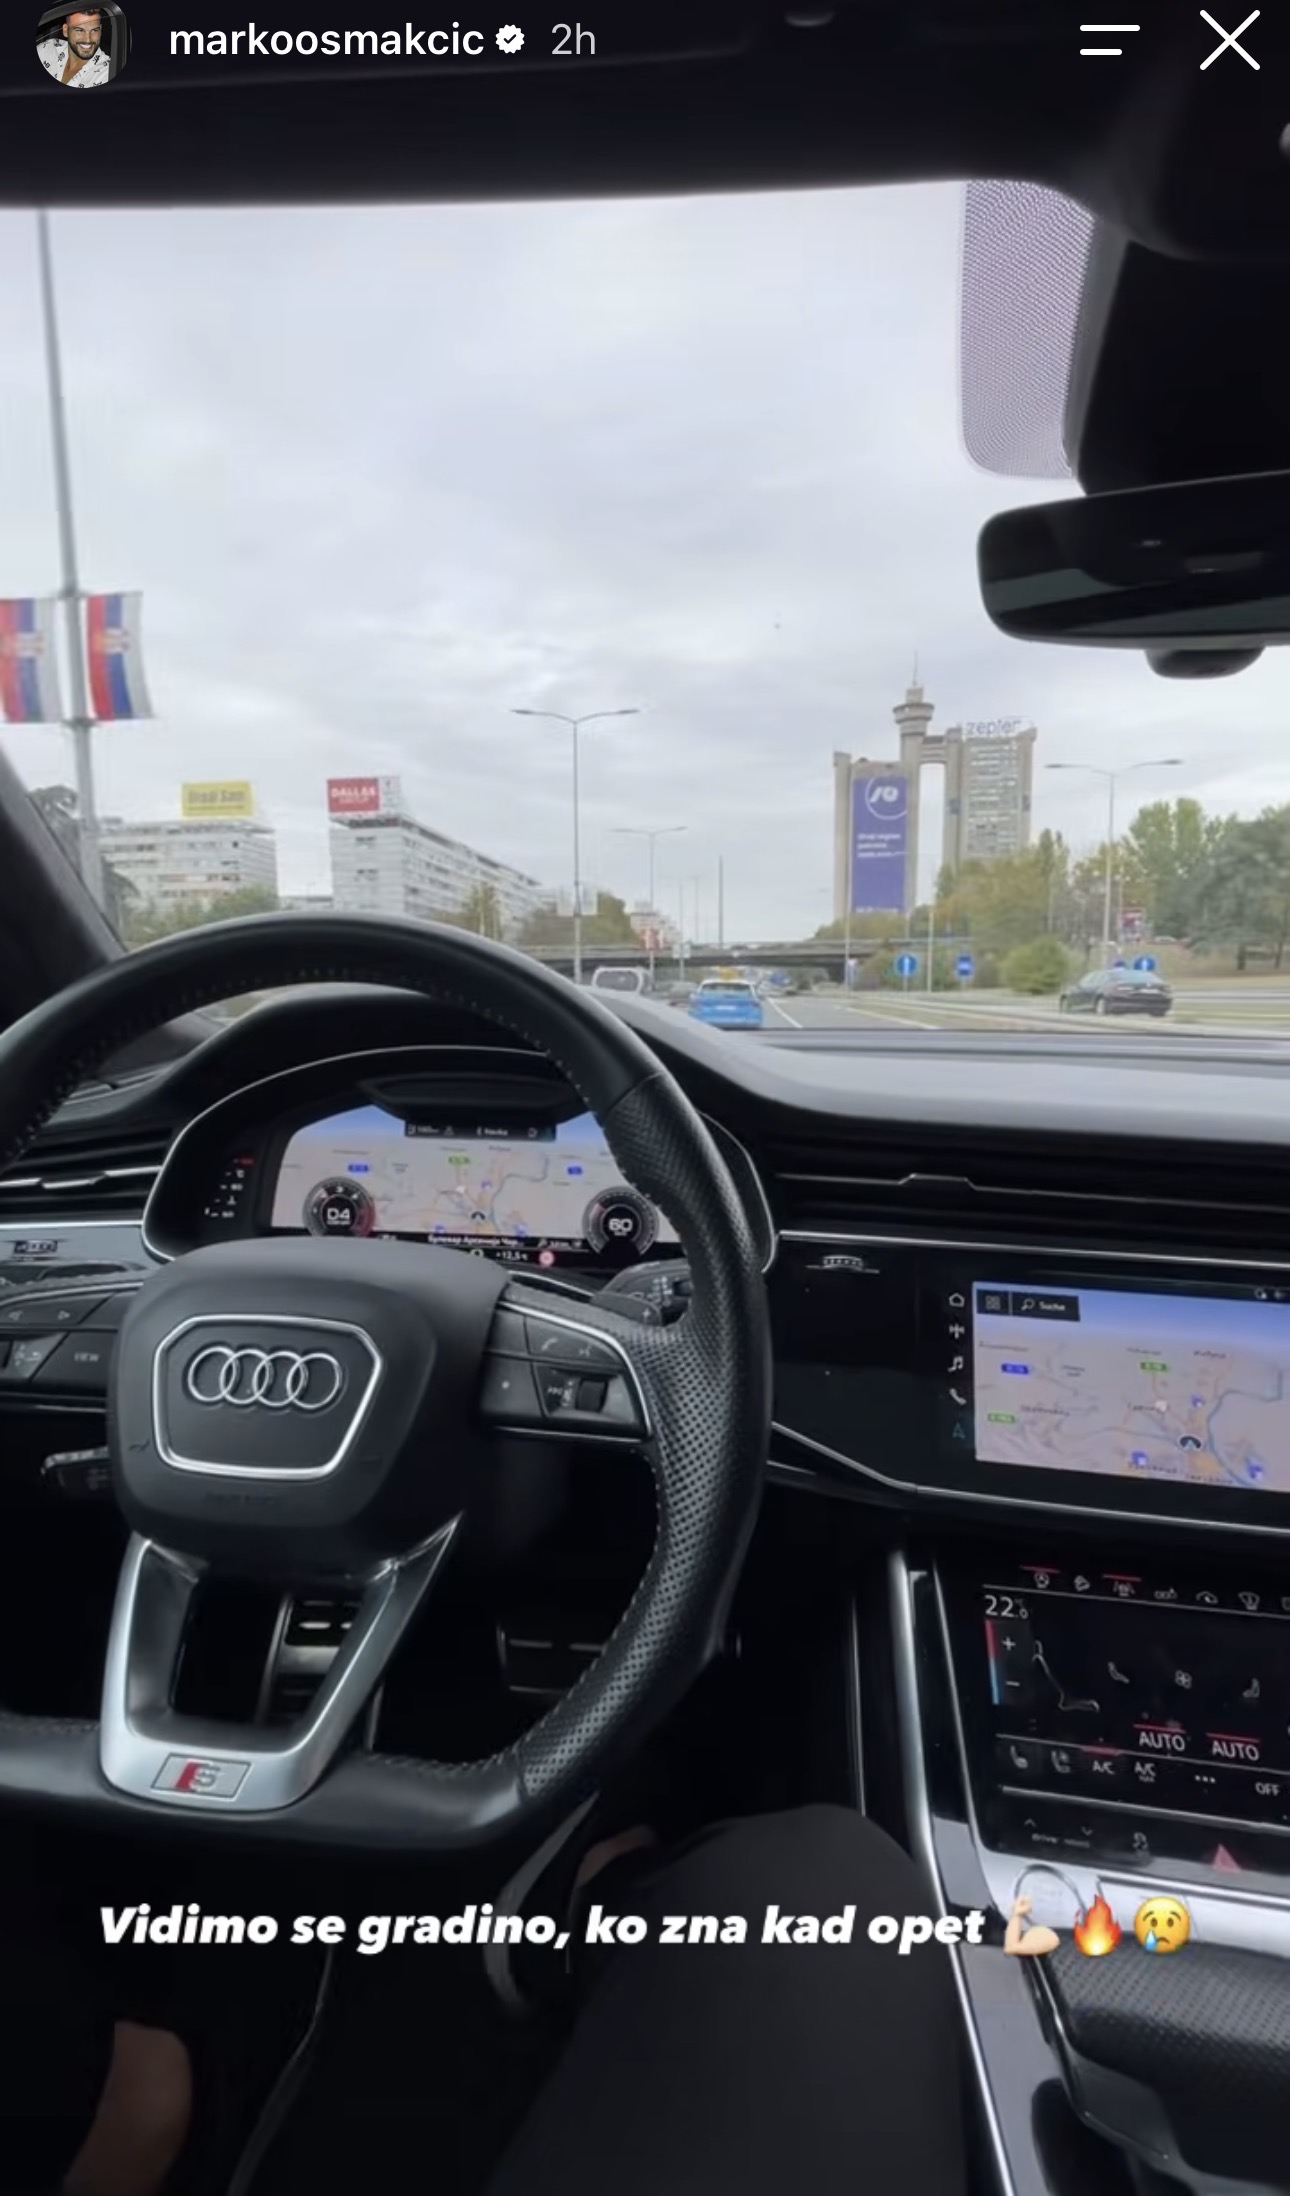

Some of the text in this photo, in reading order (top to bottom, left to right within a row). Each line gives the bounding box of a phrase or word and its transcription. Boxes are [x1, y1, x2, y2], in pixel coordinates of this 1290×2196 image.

[330, 786, 376, 798] DALLAS
[608, 1218, 633, 1232] 60
[1038, 1300, 1067, 1312] Suche
[1138, 1731, 1186, 1752] AUTO
[1211, 1740, 1260, 1763] AUTO
[1092, 1760, 1116, 1776] A/C
[1133, 1761, 1157, 1777] A/C
[1254, 1781, 1281, 1797] OFF
